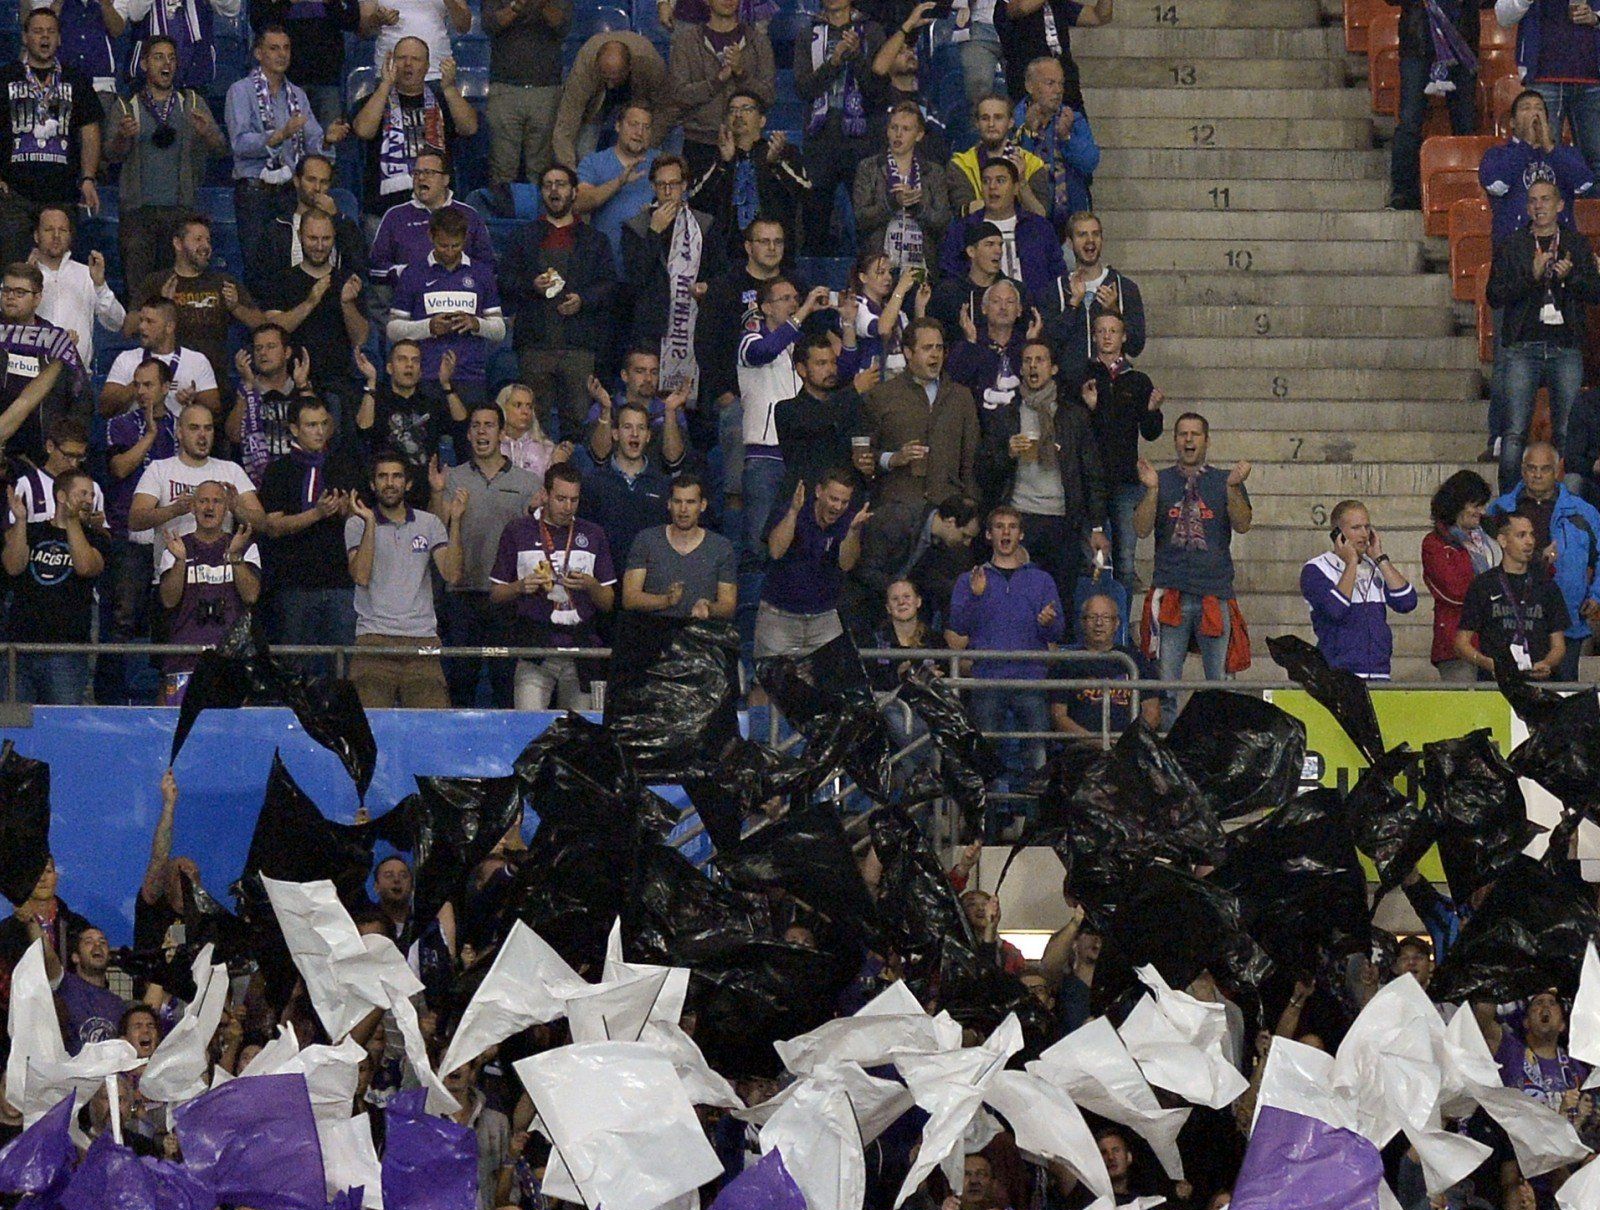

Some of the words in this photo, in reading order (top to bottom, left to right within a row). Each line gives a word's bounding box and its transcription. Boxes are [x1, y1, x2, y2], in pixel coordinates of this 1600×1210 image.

[1151, 5, 1179, 25] 14
[1169, 66, 1197, 85] 13
[1188, 125, 1215, 146] 12
[1208, 187, 1230, 208] 11
[1224, 250, 1252, 271] 10
[428, 297, 475, 309] Verbund
[1254, 313, 1270, 334] 9
[8, 360, 39, 372] erbun
[1272, 376, 1288, 398] 8
[1290, 438, 1303, 459] 7
[1311, 504, 1327, 526] 6
[29, 548, 75, 567] LACOST
